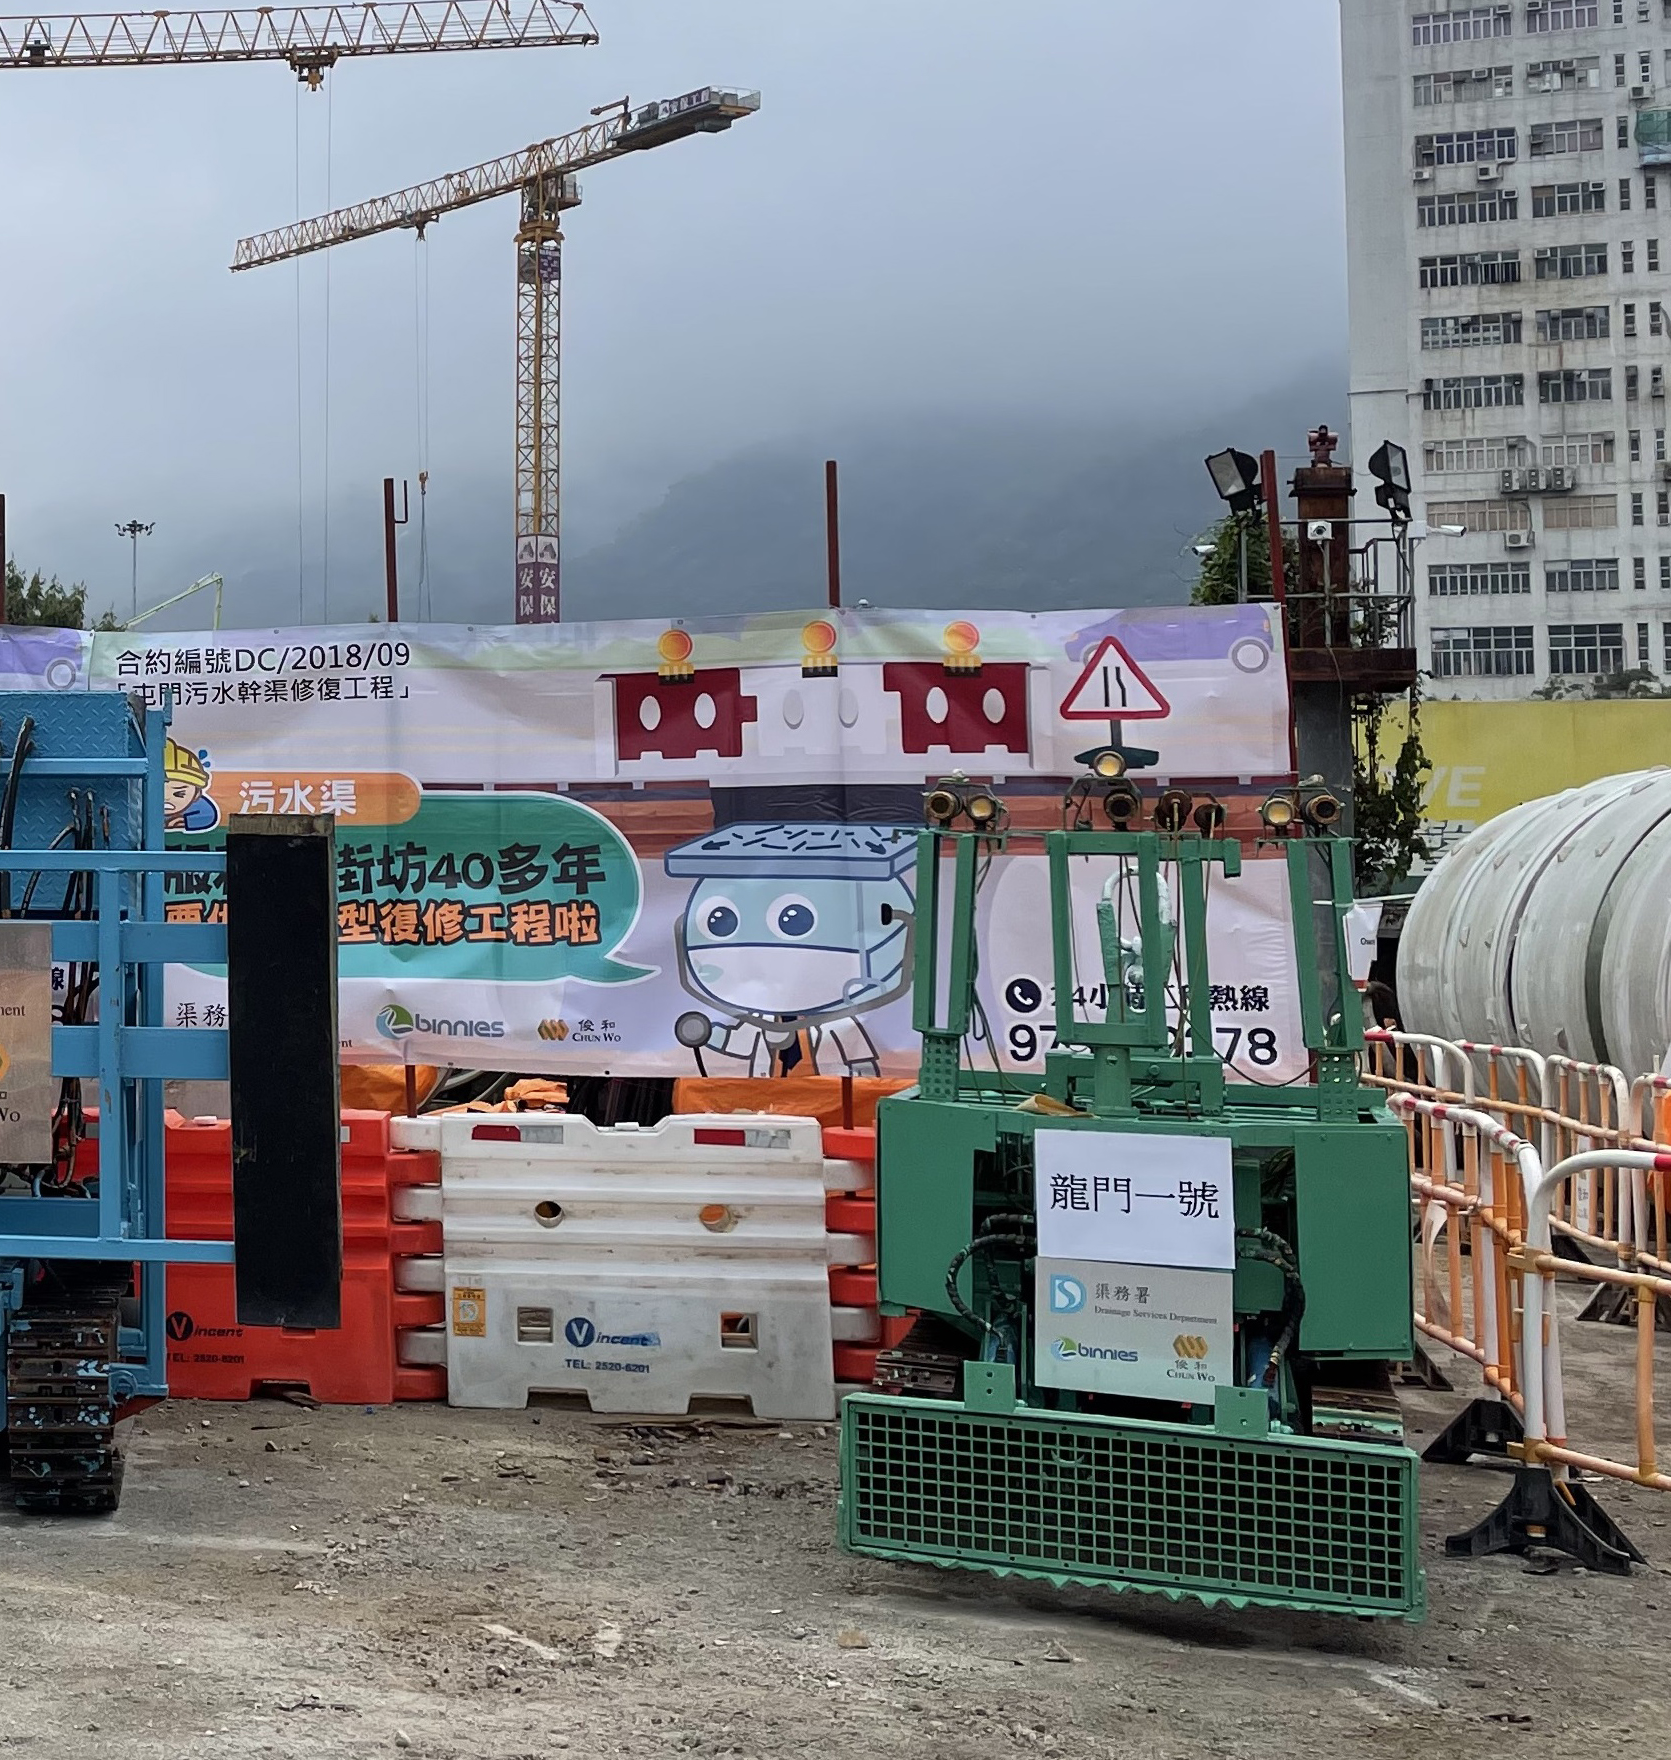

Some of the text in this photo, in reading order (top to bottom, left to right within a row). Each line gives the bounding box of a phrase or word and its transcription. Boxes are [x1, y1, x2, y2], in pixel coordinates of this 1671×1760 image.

[519, 567, 534, 617] 安保
[539, 567, 557, 616] 安保
[115, 642, 411, 676] 合約編號DC/2018/09
[238, 779, 357, 817] 污水渠
[415, 1013, 505, 1038] binnies
[1049, 1172, 1220, 1219] 龍門一號
[166, 1311, 244, 1342] Vincent
[565, 1317, 649, 1348] Vincent
[565, 1359, 651, 1374] TEL: 2520-6201
[1078, 1342, 1139, 1363] binnies
